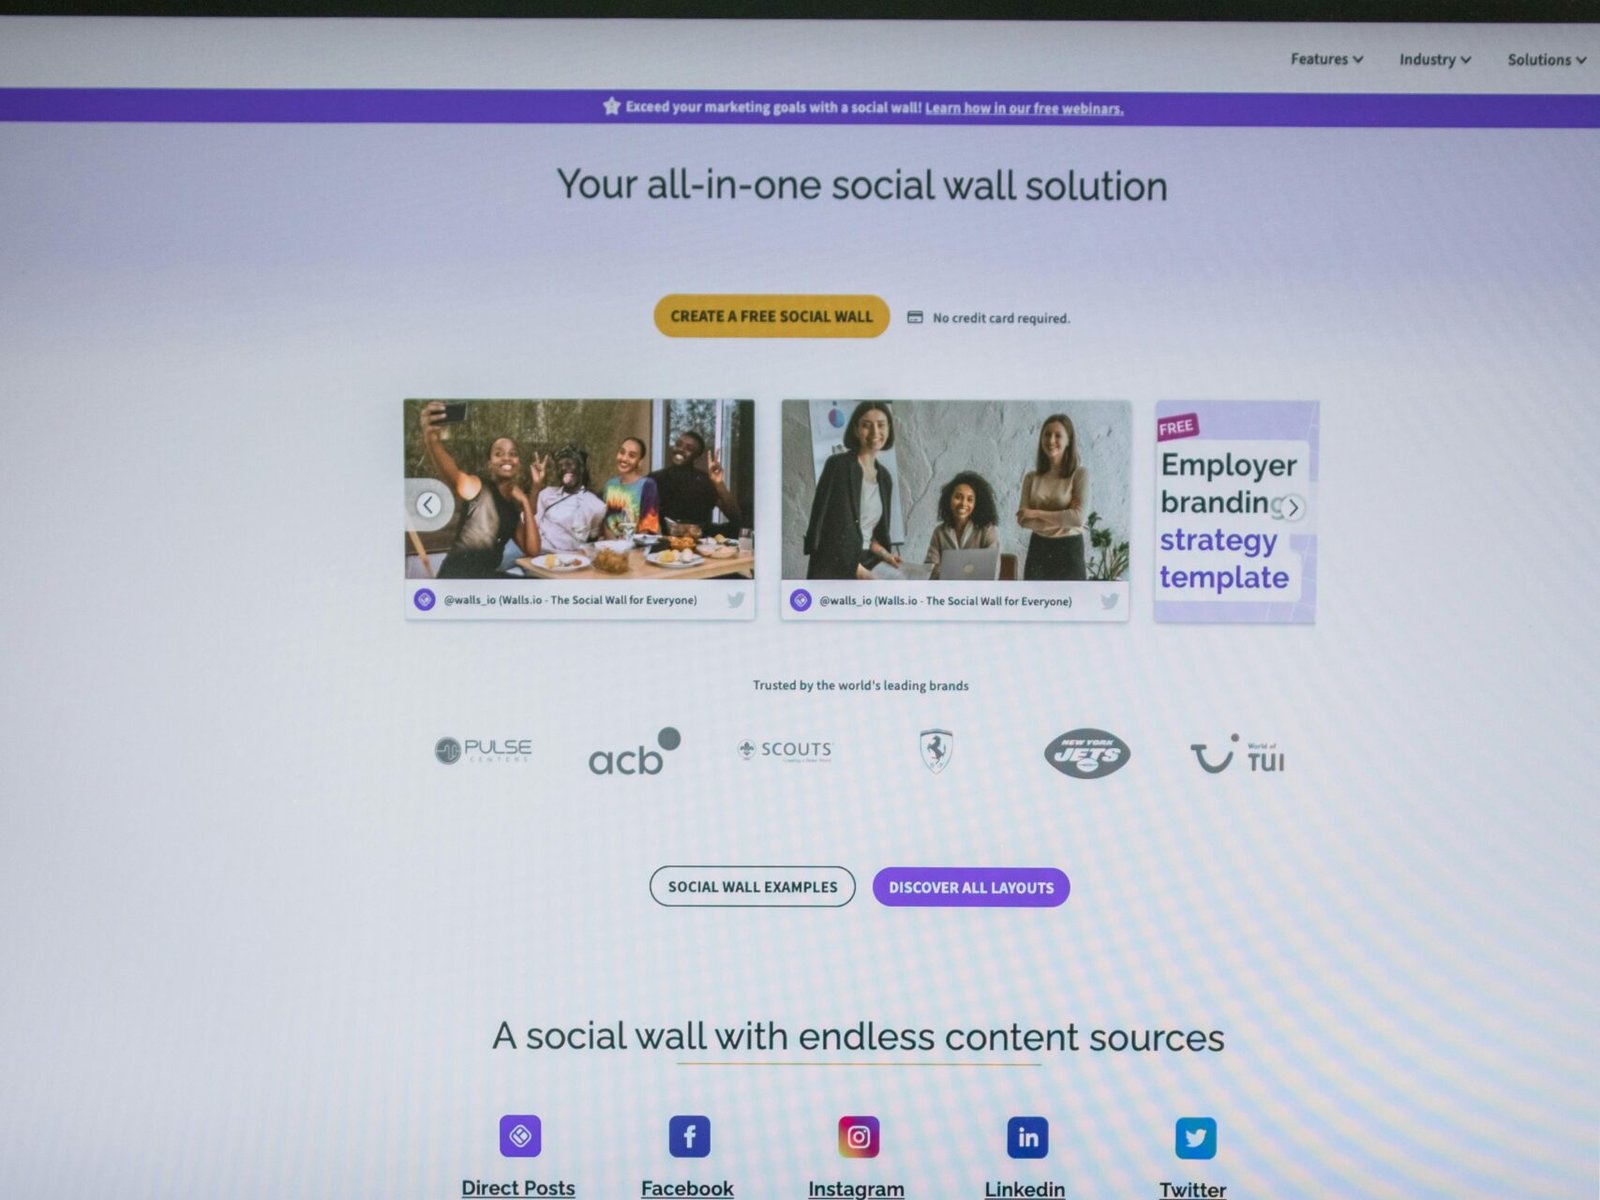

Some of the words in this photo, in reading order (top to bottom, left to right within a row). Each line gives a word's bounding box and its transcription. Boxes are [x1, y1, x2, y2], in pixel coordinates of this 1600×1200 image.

[1291, 52, 1349, 66] Features
[1399, 52, 1457, 70] Industry
[1507, 52, 1572, 67] Solutions
[625, 100, 670, 113] Exceed
[672, 103, 703, 116] your
[704, 100, 771, 117] marketing
[773, 100, 807, 117] goals
[809, 100, 839, 114] with
[840, 103, 849, 114] a
[851, 100, 889, 114] social
[890, 101, 923, 114] wall!
[925, 102, 961, 115] Learn
[964, 102, 993, 115] how
[994, 102, 1006, 115] in
[1008, 104, 1031, 115] our
[1034, 102, 1060, 115] free
[1062, 103, 1125, 116] webinars.
[557, 167, 639, 199] Your
[647, 167, 822, 200] all-in-one
[832, 167, 936, 201] social
[943, 168, 1018, 201] wall
[1025, 169, 1167, 202] solution
[670, 309, 725, 323] CREATE
[727, 309, 738, 323] A
[740, 309, 777, 323] FREE
[779, 309, 832, 323] SOCIAL
[834, 309, 874, 323] WALL
[933, 312, 950, 324] No
[951, 311, 987, 324] credit
[989, 311, 1015, 324] card
[1017, 312, 1071, 327] required.
[1159, 418, 1195, 437] FREE
[1162, 452, 1298, 483] Employer
[1160, 527, 1278, 559] strategy
[1159, 564, 1290, 595] template
[443, 594, 497, 607] @walls_io
[498, 594, 543, 607] (Walls.io
[550, 595, 570, 605] The
[572, 595, 603, 605] Social
[604, 594, 628, 605] Wall
[629, 594, 645, 605] for
[645, 595, 698, 608] Everyone)
[819, 595, 873, 607] @walls_io
[874, 595, 918, 607] (Walls.io
[926, 595, 946, 606] The
[947, 595, 979, 606] Social
[980, 595, 1003, 607] Wall
[1004, 595, 1020, 607] for
[1021, 596, 1073, 609] Everyone)
[753, 679, 797, 691] Trusted
[799, 679, 814, 693] by
[816, 679, 836, 691] the
[838, 679, 881, 691] world's
[883, 679, 927, 695] leading
[929, 679, 970, 691] brands
[464, 739, 533, 755] PULSE
[761, 741, 832, 757] SCOUTS
[1054, 747, 1121, 762] JETS
[588, 744, 664, 776] acb
[1247, 753, 1285, 772] TUI
[668, 880, 719, 893] SOCIAL
[722, 881, 761, 893] WALL
[764, 881, 838, 894] EXAMPLES
[889, 881, 959, 894] DISCOVER
[961, 881, 988, 895] ALL
[991, 881, 1055, 895] LAYOUTS
[492, 1021, 518, 1050] A
[526, 1020, 628, 1050] social
[634, 1020, 708, 1051] wall
[714, 1020, 788, 1051] with
[799, 1021, 935, 1051] endless
[945, 1022, 1080, 1052] content
[1089, 1029, 1225, 1053] sources
[462, 1179, 520, 1196] Direct
[524, 1179, 576, 1196] Posts
[641, 1179, 735, 1197] Facebook
[807, 1181, 905, 1200] Instagram
[985, 1181, 1066, 1198] Linkedin
[1159, 1181, 1227, 1199] Twitter
